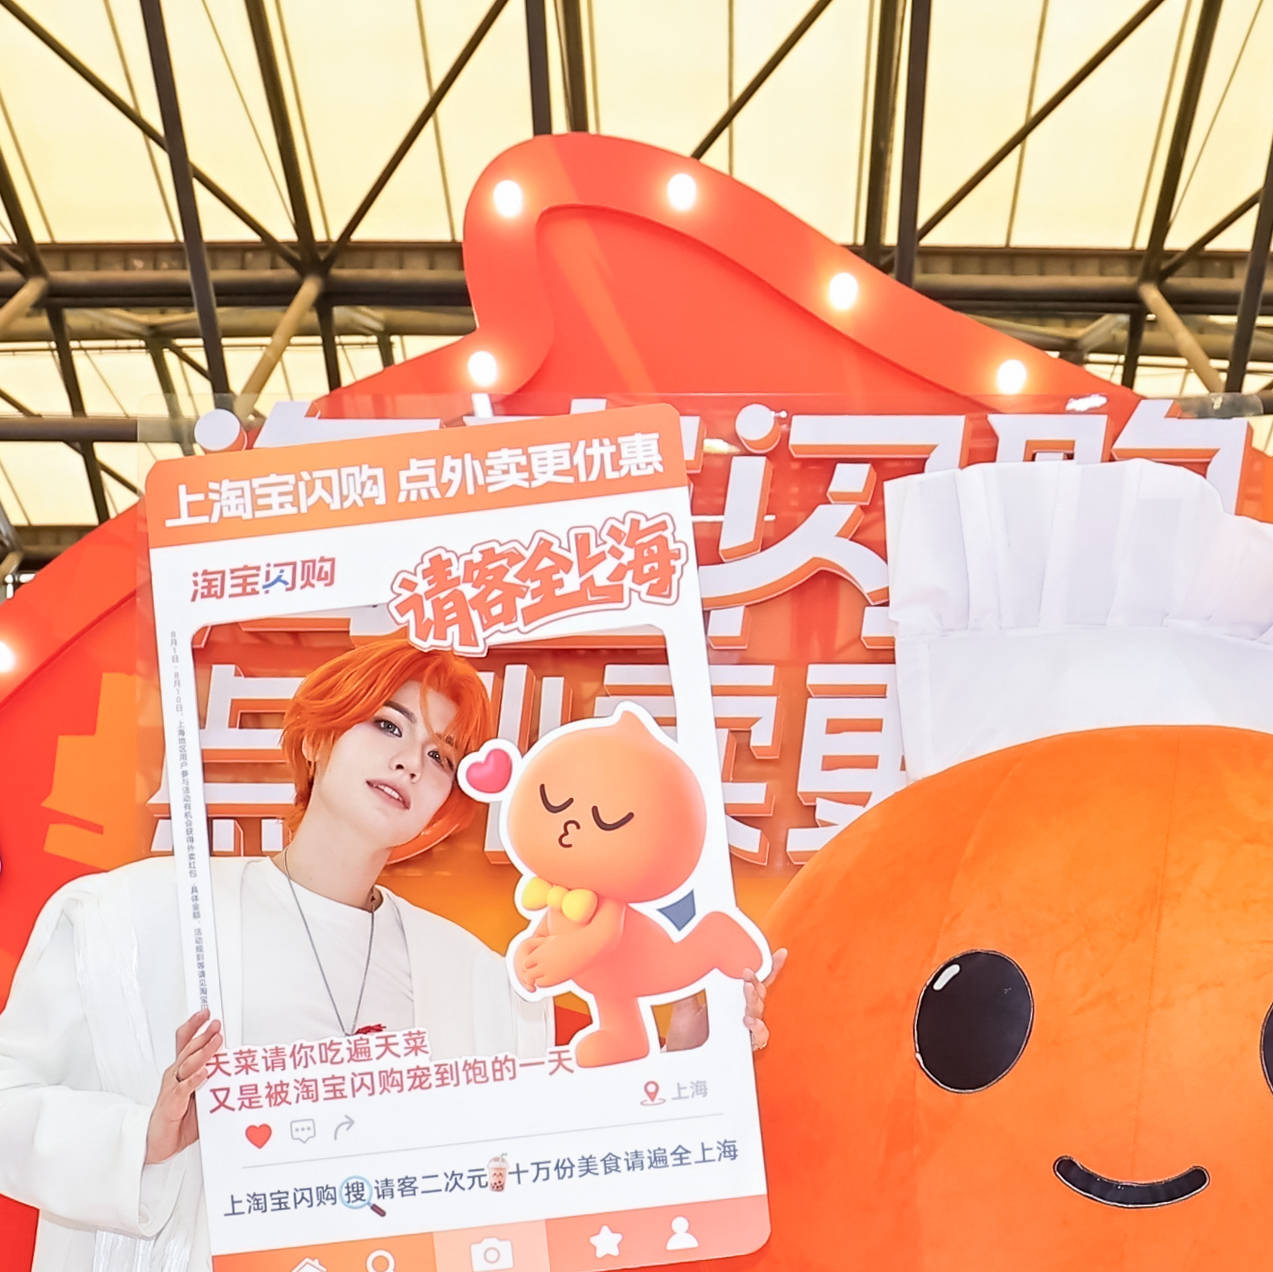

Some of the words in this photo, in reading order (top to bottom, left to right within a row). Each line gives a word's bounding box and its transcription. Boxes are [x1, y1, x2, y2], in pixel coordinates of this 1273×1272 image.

[164, 464, 387, 528] 上淘宝闪购
[397, 432, 665, 504] 点外卖更优惠
[189, 556, 336, 602] 淘宝闪购
[392, 514, 685, 652] 请客全上海
[206, 1030, 431, 1079] 天菜请你吃遍天菜
[209, 1049, 575, 1114] 又是被淘宝闪购宠到饱的一天
[671, 1080, 709, 1101] 上海
[223, 1183, 337, 1218] 上淘宝闪购
[344, 1179, 367, 1205] 搜
[373, 1167, 489, 1202] 请客二次元
[508, 1138, 739, 1185] 十万份美食请遍全上海
